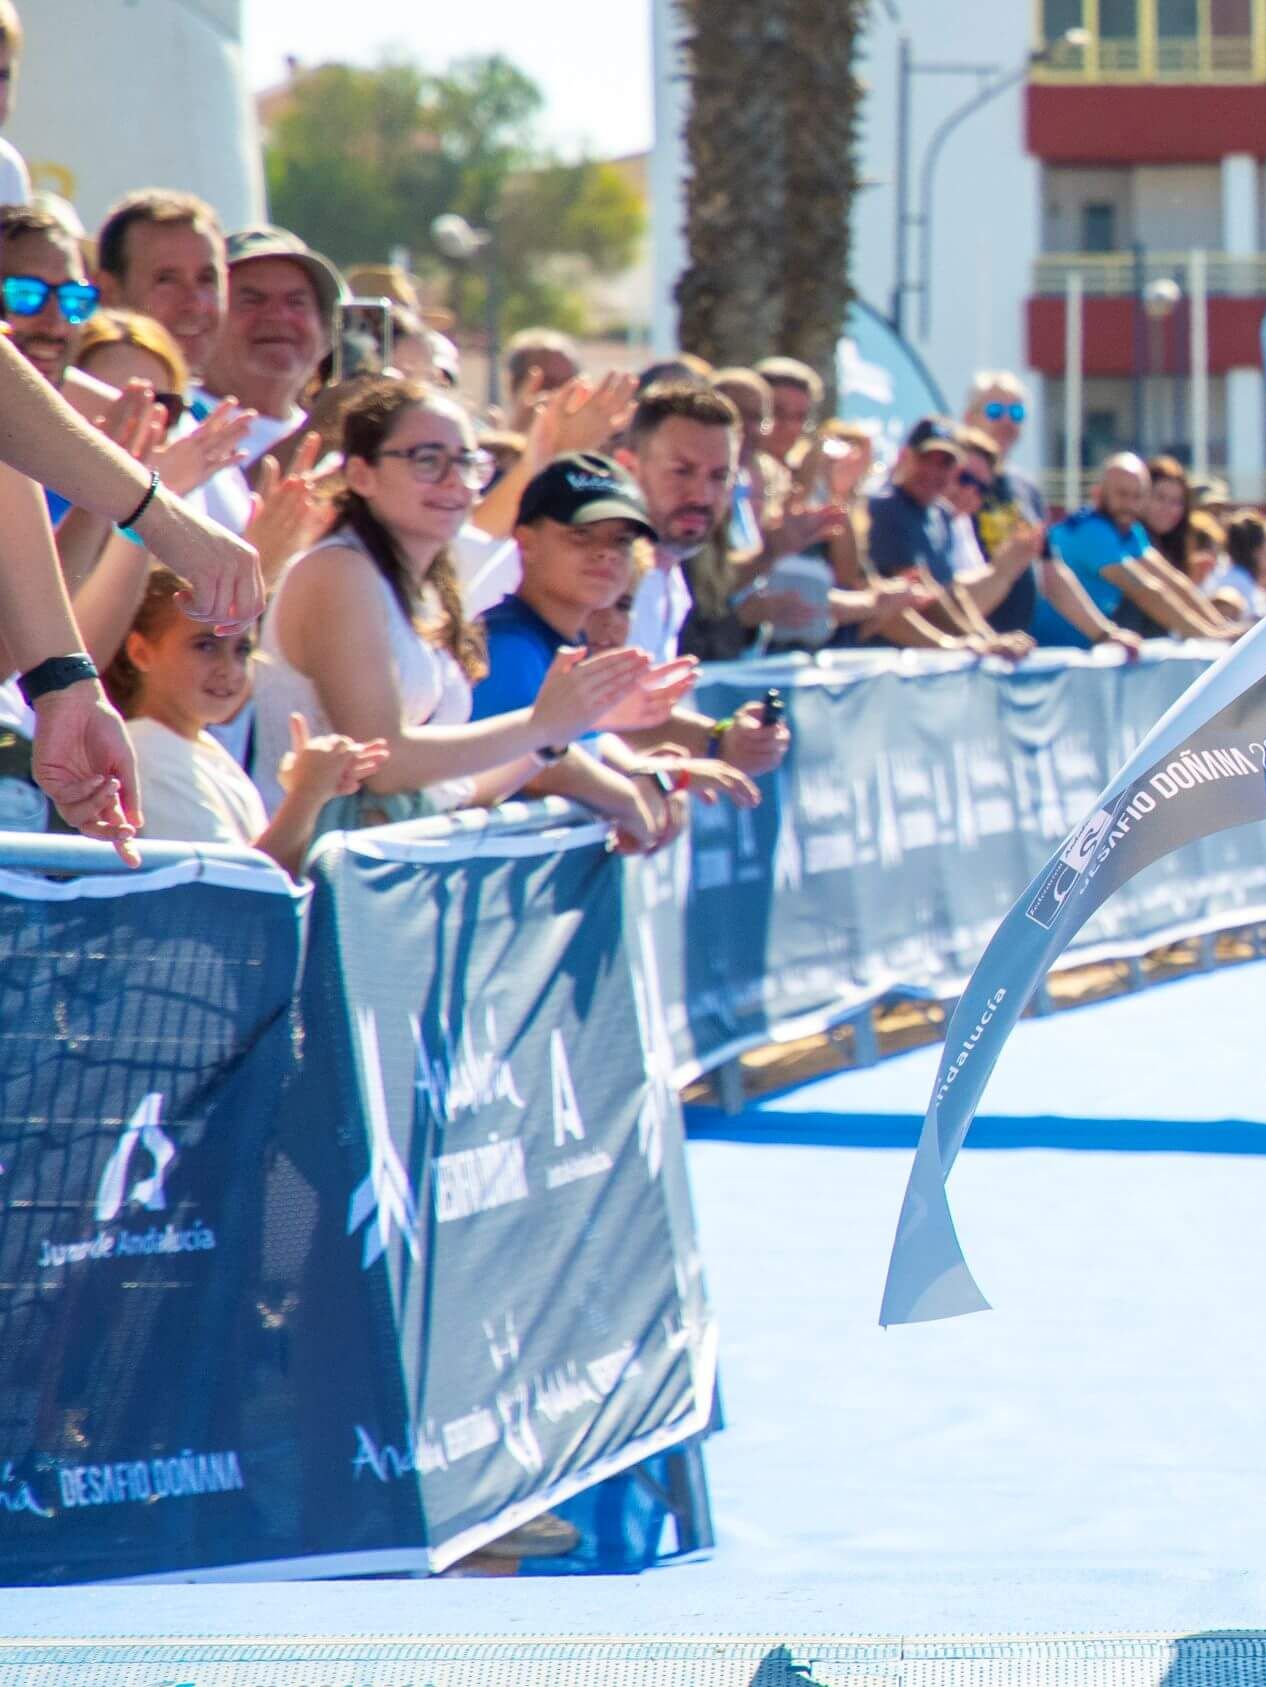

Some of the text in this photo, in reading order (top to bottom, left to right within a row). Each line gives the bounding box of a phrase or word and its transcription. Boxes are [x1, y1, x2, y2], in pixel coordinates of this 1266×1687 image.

[1150, 748, 1260, 799] DOÑANA
[935, 986, 1008, 1107] ndalucía
[59, 1459, 150, 1508] DESAFIO
[151, 1448, 244, 1498] DOÑANA
